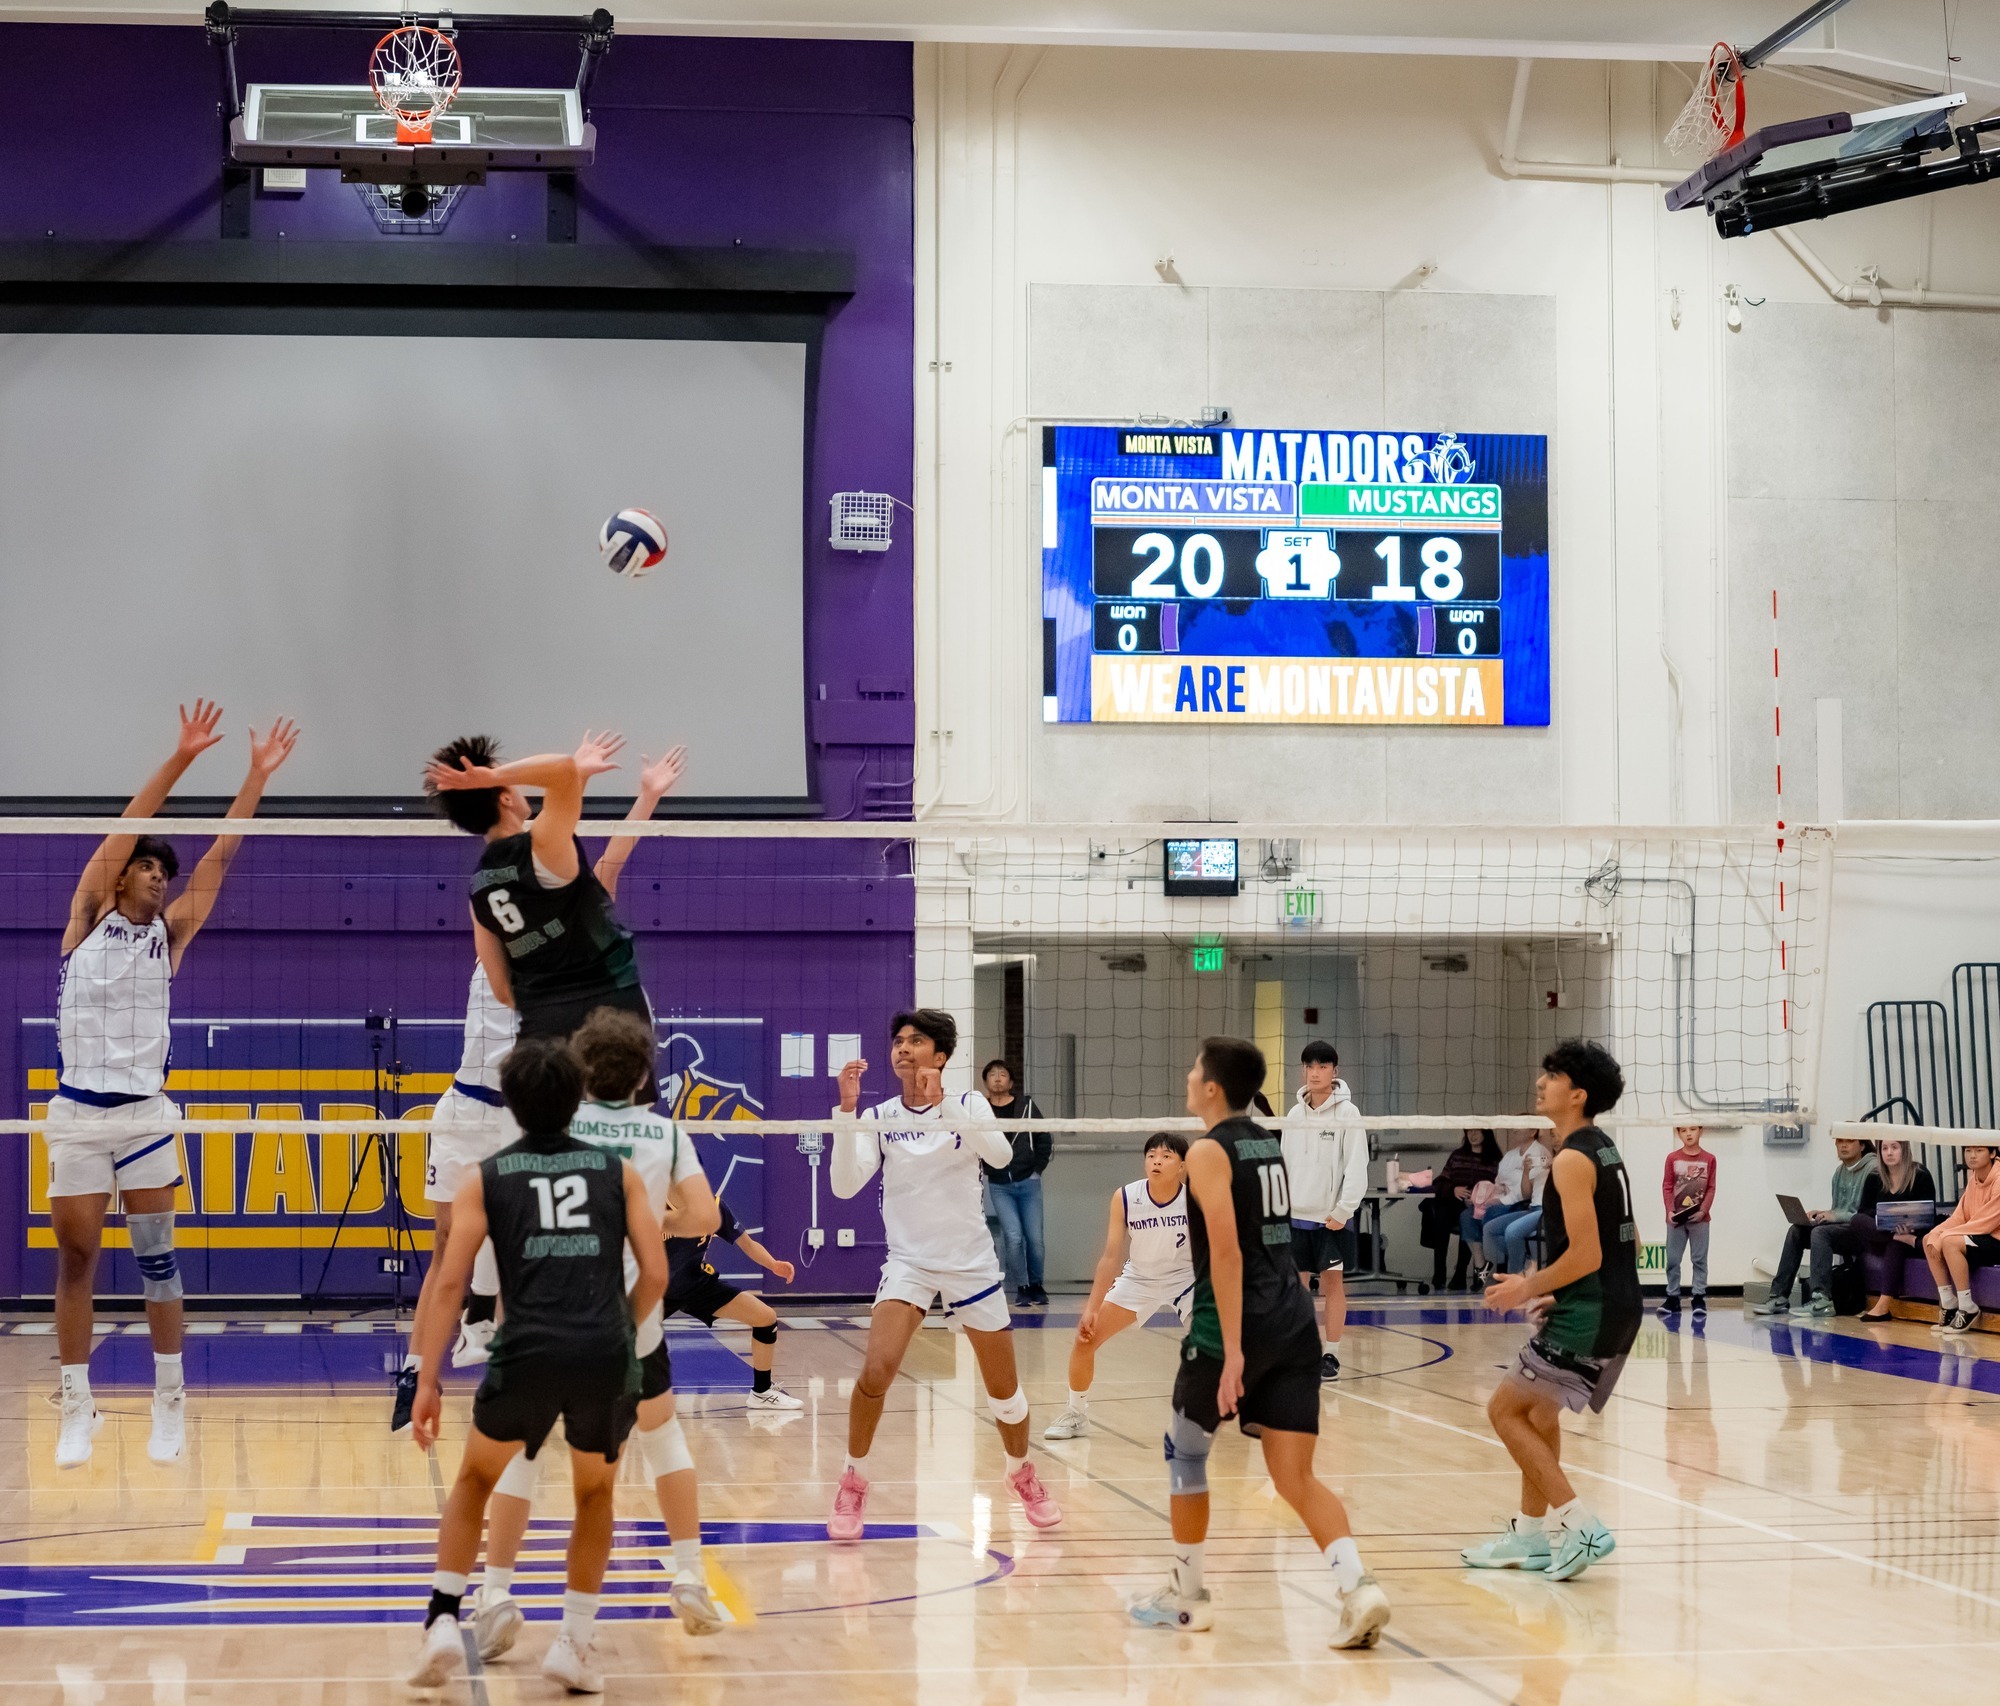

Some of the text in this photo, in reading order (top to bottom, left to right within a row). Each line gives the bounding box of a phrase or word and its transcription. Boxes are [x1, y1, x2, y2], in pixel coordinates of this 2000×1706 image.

[1125, 434, 1213, 455] MONTA VISTA
[1221, 431, 1425, 484] MATADORS
[1096, 485, 1281, 512] MONTA VISTA
[1348, 489, 1496, 515] MUSTANGS
[1284, 536, 1312, 547] SET
[1131, 532, 1225, 598] 20
[1286, 553, 1311, 591] 1
[1371, 535, 1464, 602] 18
[1118, 623, 1138, 652] 0
[1457, 627, 1478, 655] 0
[487, 888, 525, 934] 6
[1286, 892, 1316, 916] EXIT
[1194, 948, 1223, 971] EXIT
[528, 1175, 590, 1230] 12
[1257, 1163, 1289, 1217] 10
[1129, 1214, 1187, 1230] MONTA VISTA
[1176, 1233, 1186, 1248] 2
